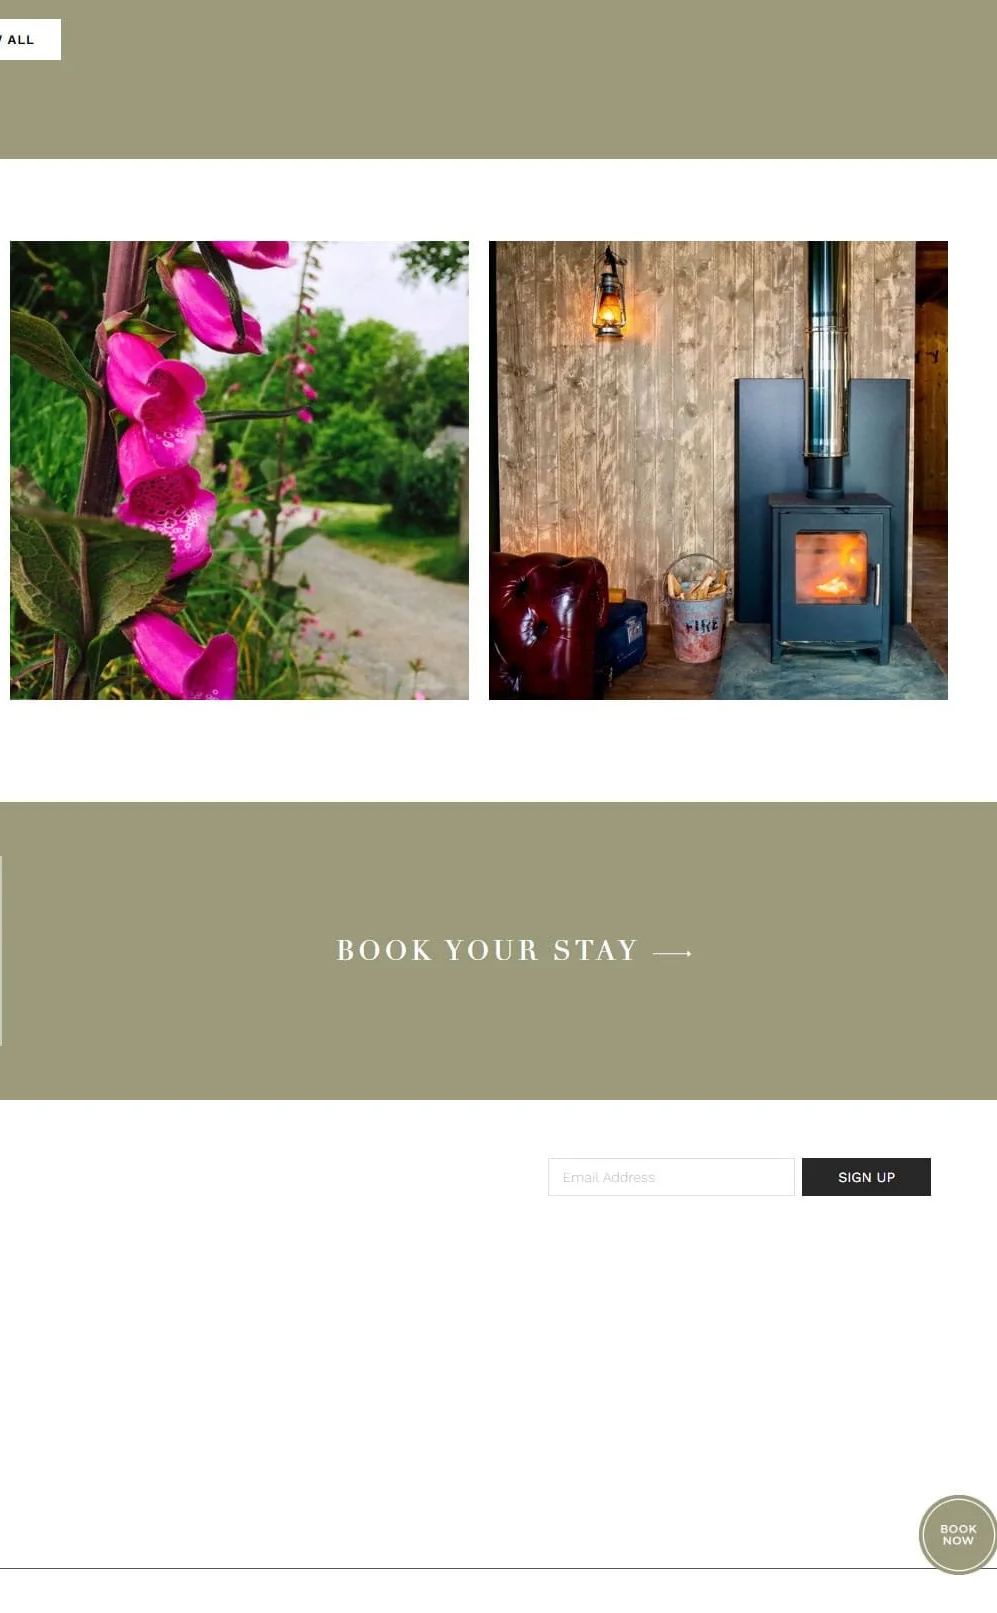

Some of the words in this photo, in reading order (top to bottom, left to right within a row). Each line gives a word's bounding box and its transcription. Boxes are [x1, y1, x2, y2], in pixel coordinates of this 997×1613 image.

[6, 34, 35, 45] ALL
[336, 939, 433, 961] BOOK
[443, 939, 539, 961] YOUR
[553, 939, 637, 961] STAY
[563, 1171, 599, 1184] Email
[602, 1171, 655, 1183] Address
[838, 1171, 872, 1184] SIGN
[876, 1171, 896, 1184] UP
[940, 1524, 977, 1534] BOOK
[943, 1535, 974, 1546] NOW
